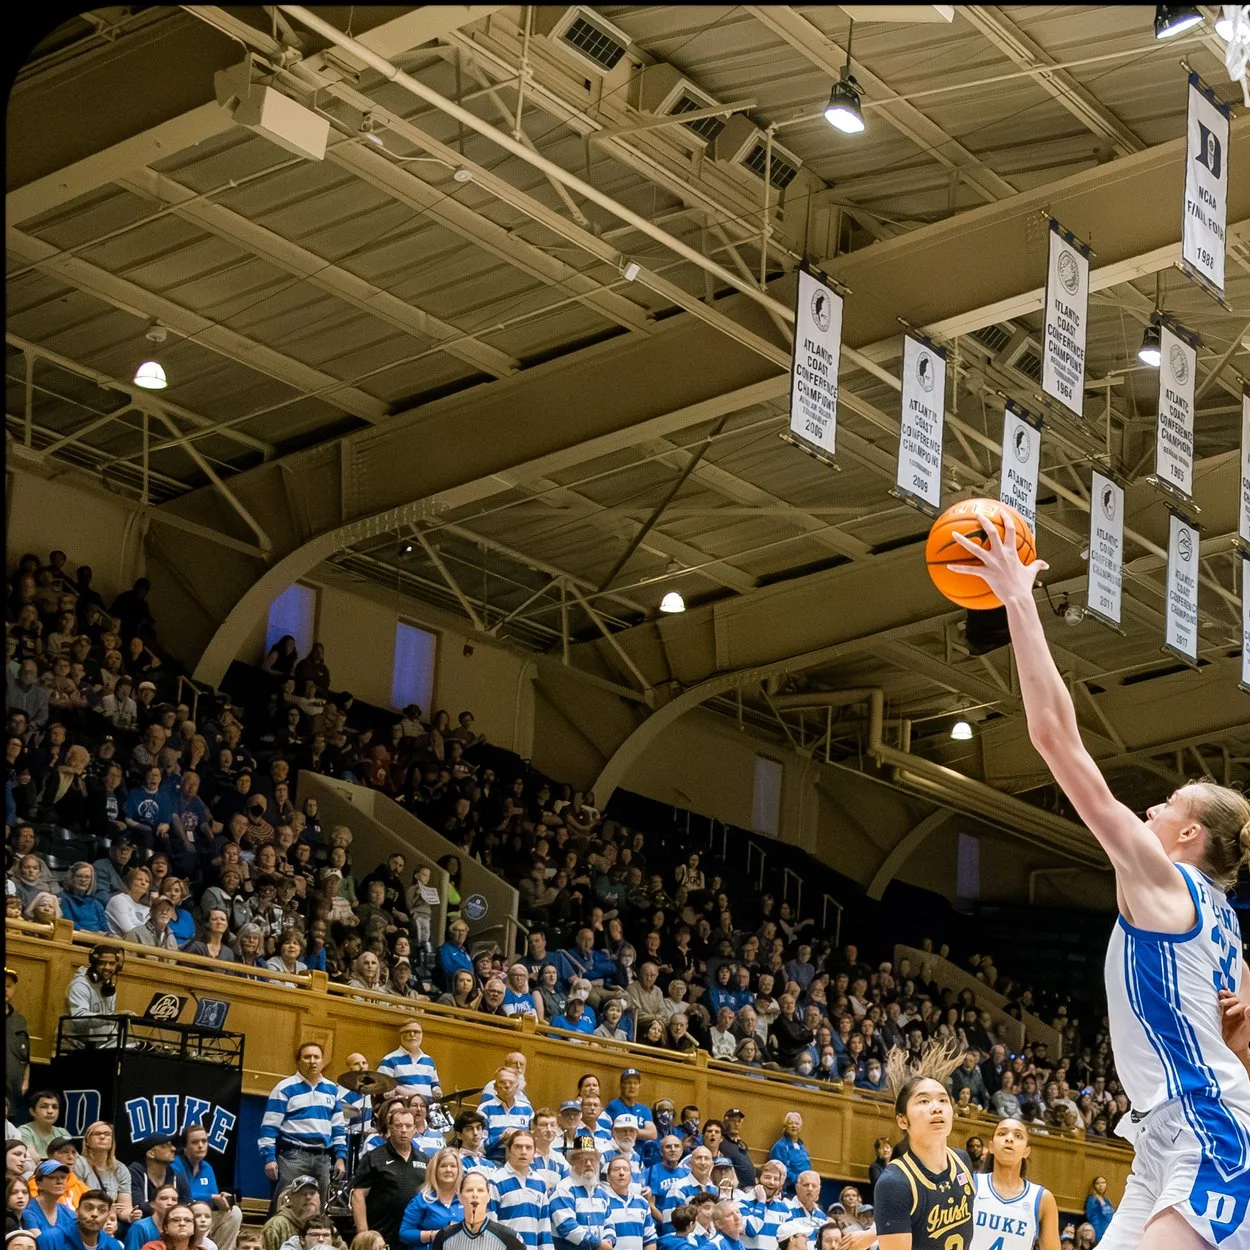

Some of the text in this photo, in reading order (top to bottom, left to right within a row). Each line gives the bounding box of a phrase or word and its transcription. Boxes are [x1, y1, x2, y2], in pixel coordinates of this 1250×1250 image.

[1198, 185, 1217, 212] NCAA
[1187, 199, 1207, 228] FINAL
[1196, 246, 1214, 270] 1988
[1054, 298, 1080, 328] ATLANTIC
[1056, 315, 1077, 340] COAST
[803, 338, 834, 366] ATLANTIC
[1047, 323, 1085, 362] CONFERENCE
[806, 355, 830, 378] COAST
[1048, 339, 1083, 376] CHAMPIONS
[796, 364, 838, 400] CONFERENCE
[1056, 379, 1073, 401] 1964
[797, 380, 836, 413] CHAMPIONS
[1165, 388, 1190, 415] ATLANTIC
[908, 398, 938, 424] ATLANTIC
[914, 414, 934, 435] COAST
[1169, 404, 1186, 426] COAST
[804, 419, 824, 440] 2006
[902, 423, 941, 457] CONFERENCE
[1160, 413, 1193, 444] CONFERENCE
[903, 438, 939, 469] CHAMPIONS
[1160, 427, 1192, 459] CHAMPIONS
[912, 474, 929, 493] 2009
[1007, 468, 1033, 493] ATLANTIC
[1012, 482, 1029, 503] COAST
[125, 1094, 237, 1154] DUKE
[926, 1196, 972, 1240] Irish
[976, 1211, 1028, 1237] DUKE
